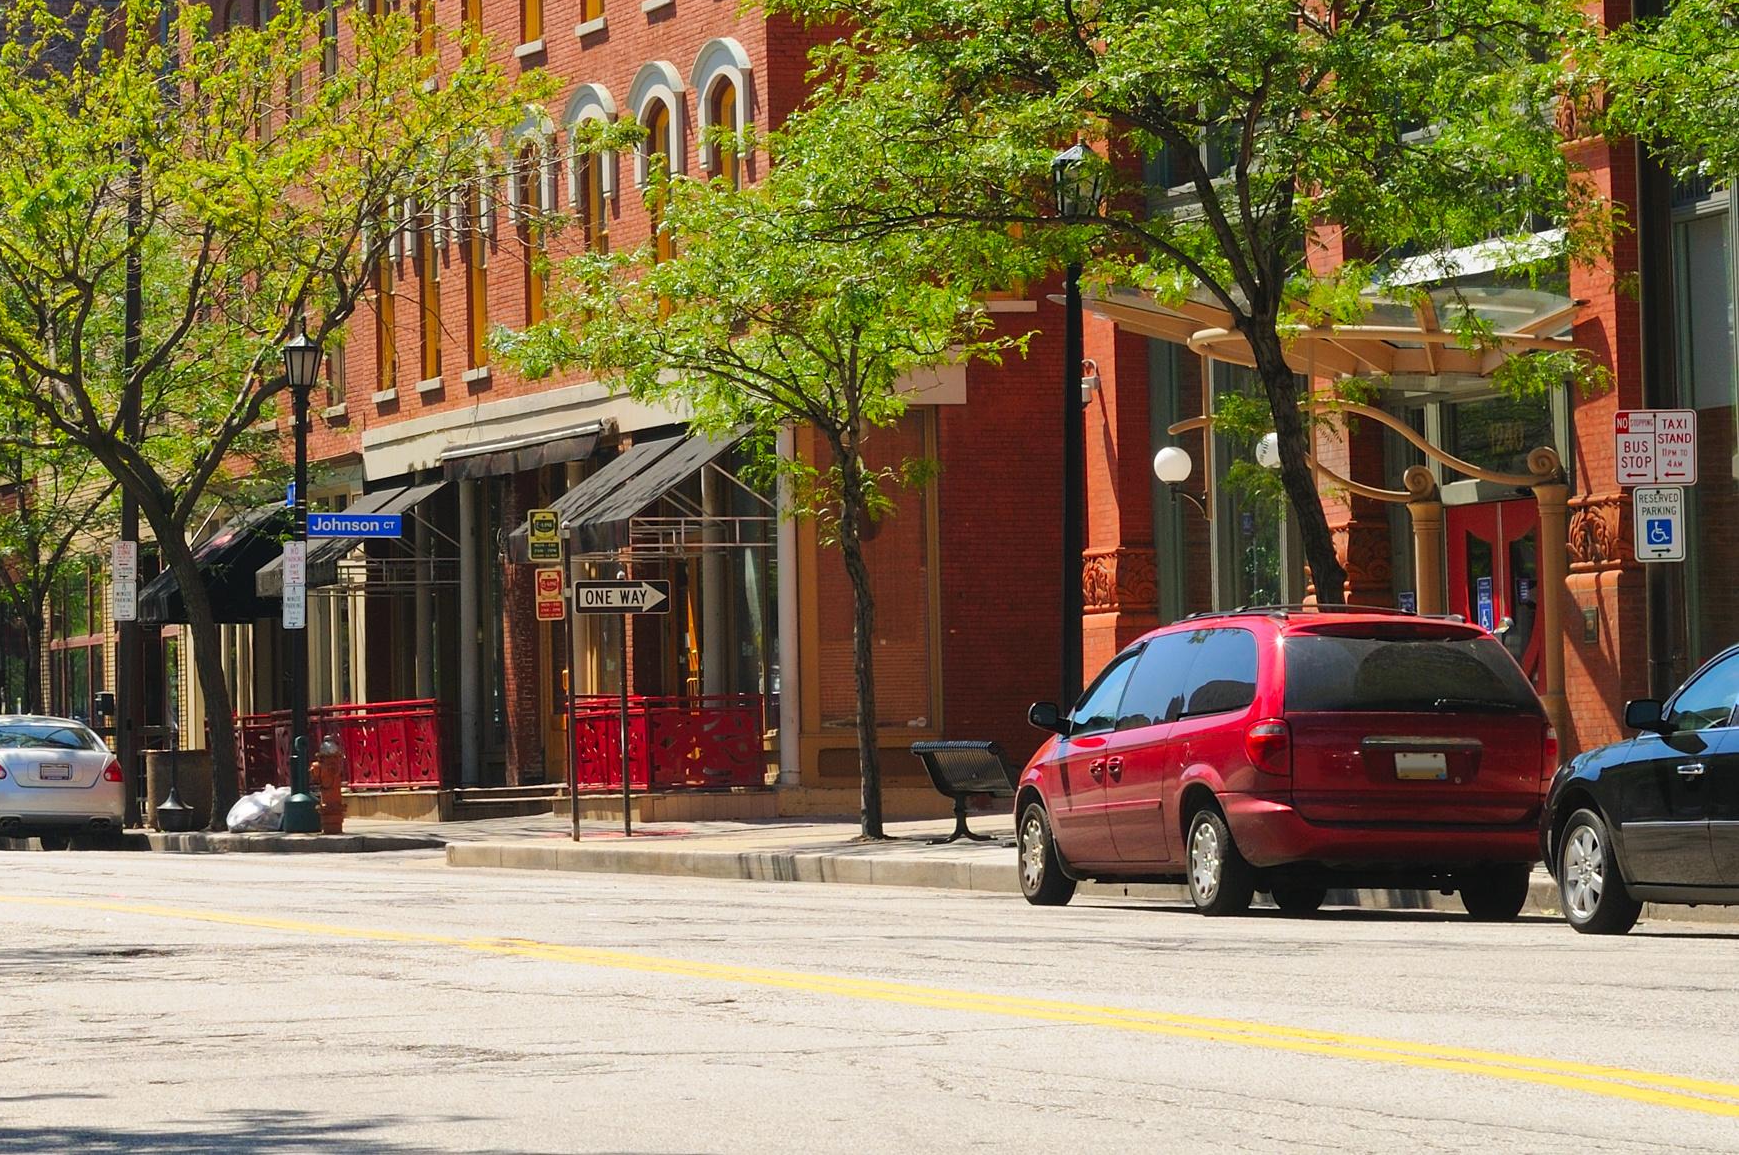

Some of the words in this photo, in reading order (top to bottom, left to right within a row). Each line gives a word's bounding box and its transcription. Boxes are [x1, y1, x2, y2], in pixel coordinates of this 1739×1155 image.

[1617, 417, 1628, 429] NO
[1630, 419, 1653, 427] STOPPING
[1662, 419, 1687, 429] TAXI
[1657, 433, 1692, 444] STAND
[1624, 441, 1648, 453] BUS
[1662, 448, 1677, 457] 11PM
[1621, 456, 1652, 468] STOP
[1638, 493, 1678, 503] RESERVED
[1641, 506, 1677, 516] PARKING
[312, 517, 379, 532] Johnson
[383, 521, 395, 529] CT
[585, 589, 613, 605] ONE
[619, 589, 648, 605] WAY
